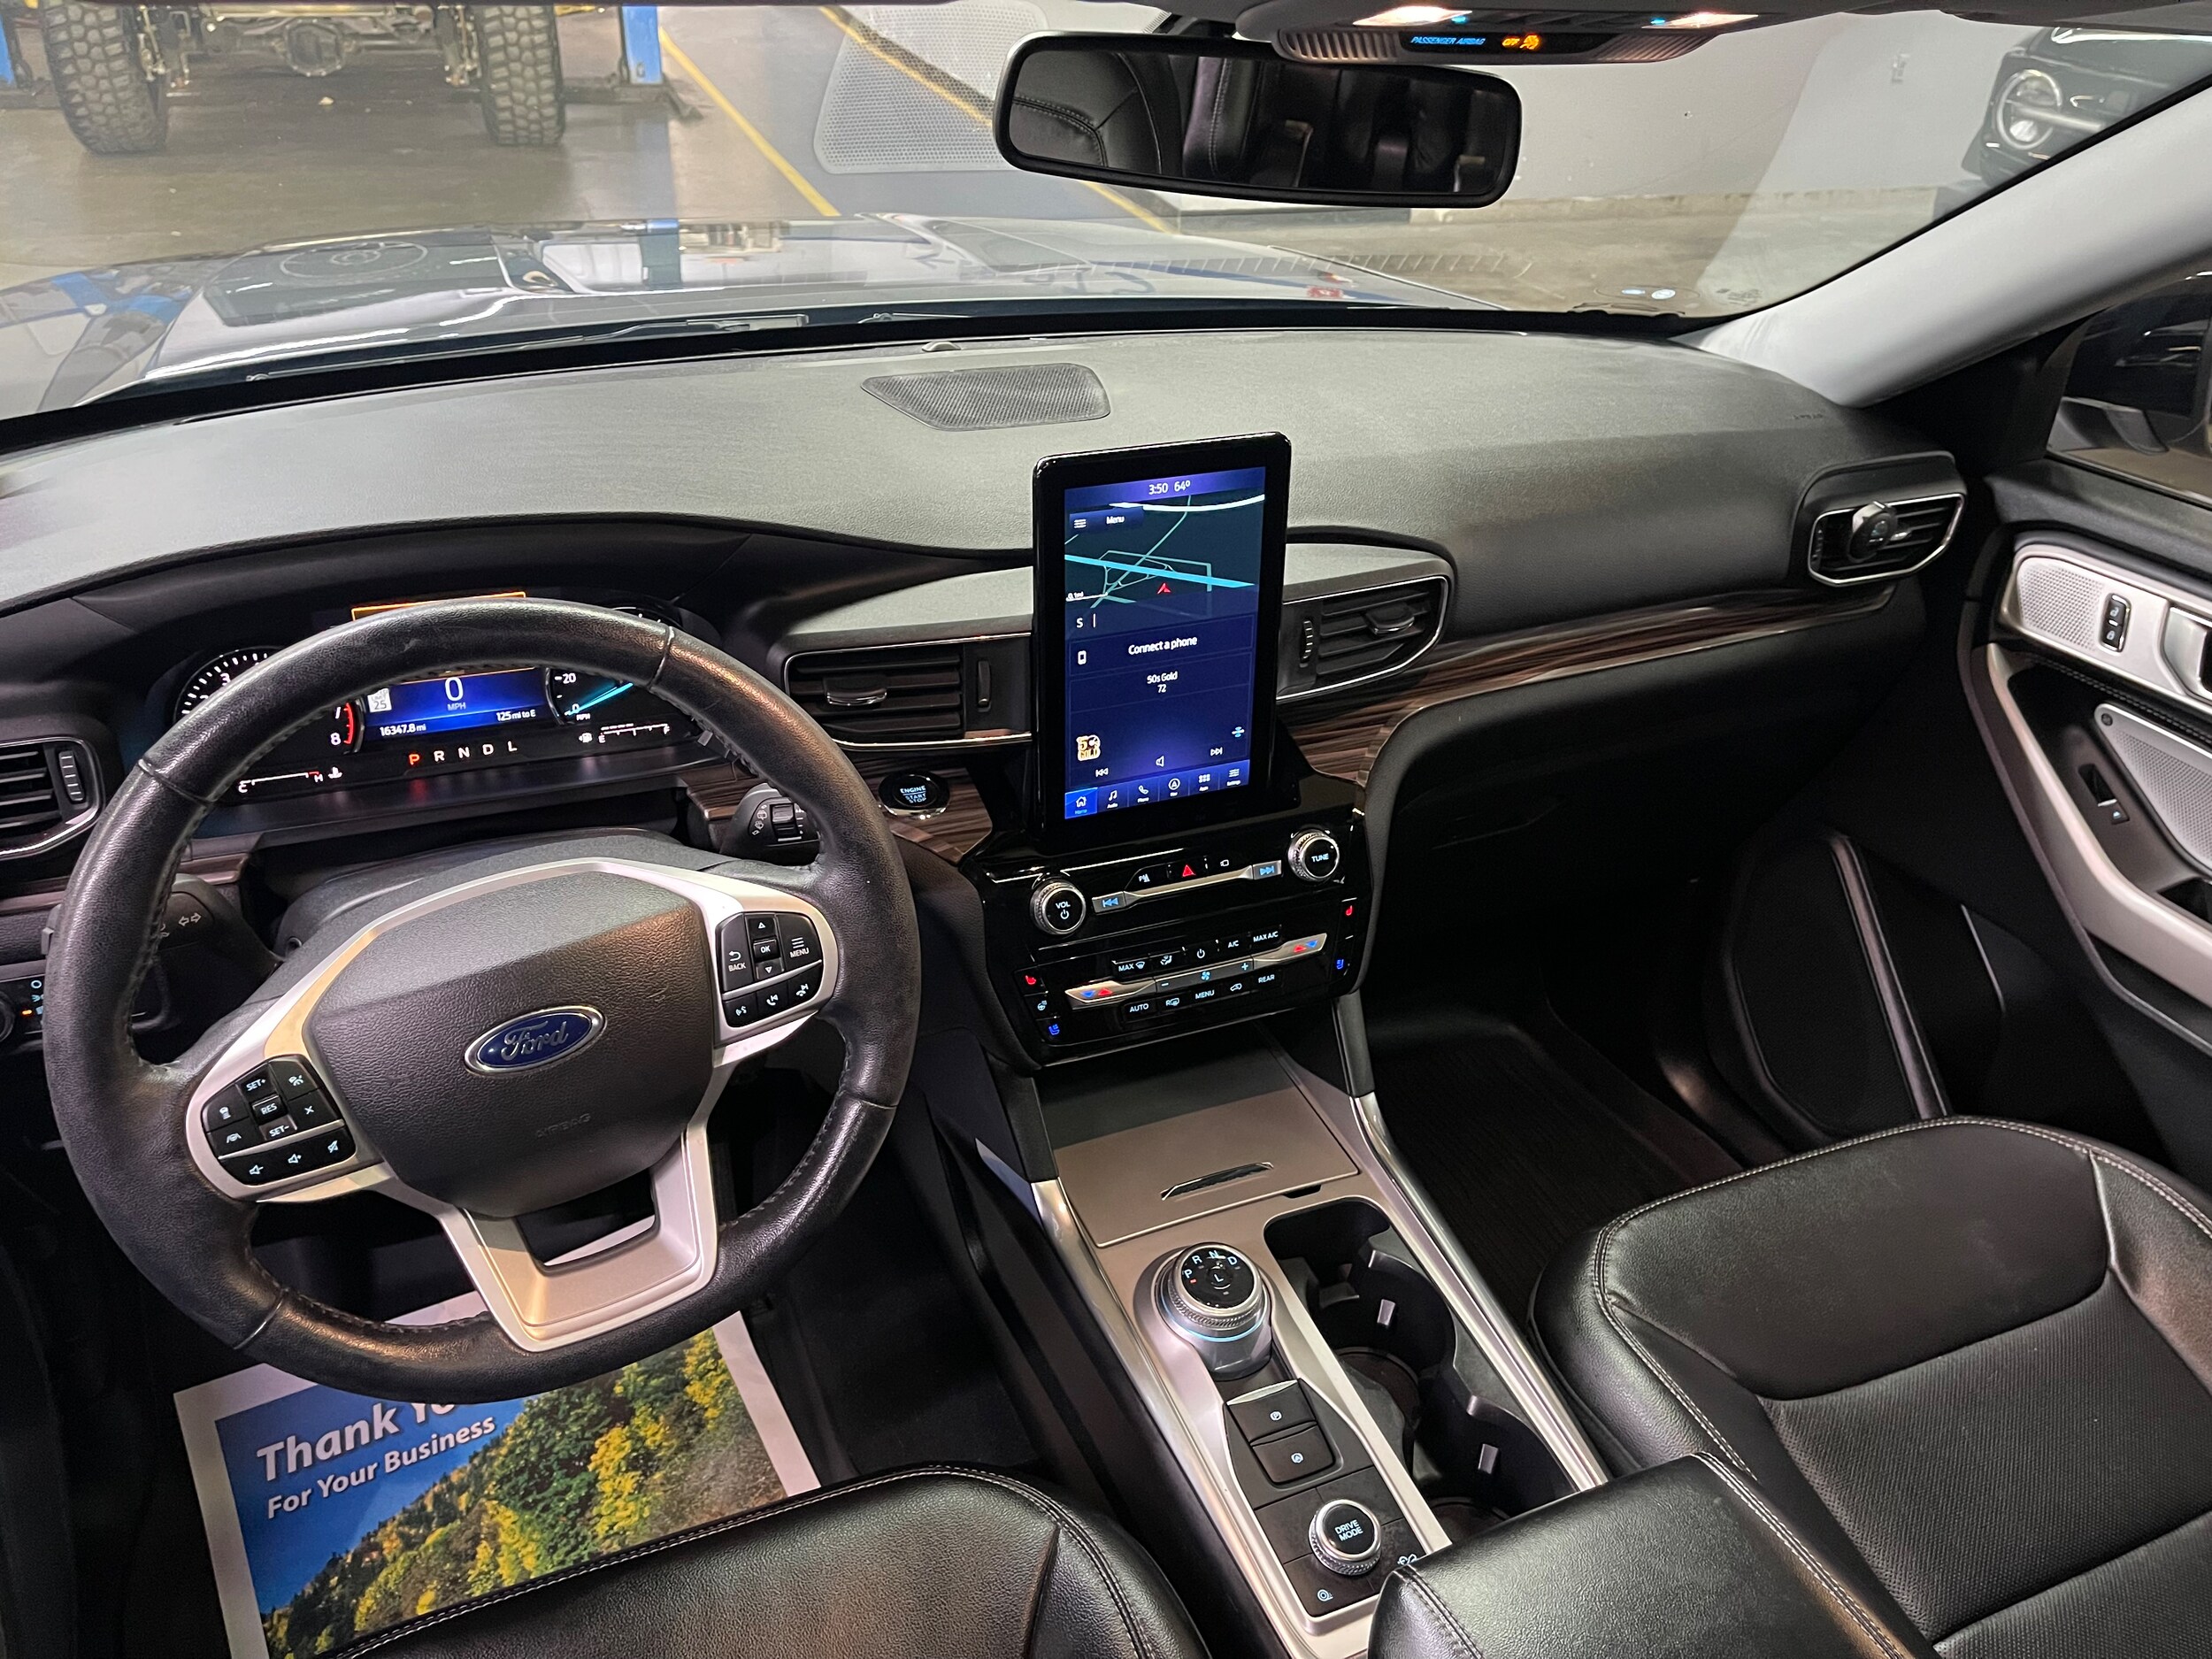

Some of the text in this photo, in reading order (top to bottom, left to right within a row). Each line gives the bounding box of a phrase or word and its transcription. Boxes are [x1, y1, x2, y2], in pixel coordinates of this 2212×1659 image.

[1410, 36, 1486, 46] PASSENGER AIRBAG
[1148, 483, 1168, 495] 3:50
[1106, 515, 1125, 525] Menu
[1076, 618, 1084, 628] S
[1128, 636, 1198, 655] Connect a phone
[563, 672, 576, 685] 20
[1162, 671, 1178, 682] Gold
[444, 677, 464, 702] 0
[1157, 683, 1167, 693] 72
[373, 700, 387, 710] 25
[447, 703, 466, 711] MPH
[496, 710, 511, 722] 125
[522, 710, 530, 718] to
[380, 723, 416, 737] 16347.8
[330, 732, 341, 746] 8
[408, 741, 518, 765] P R N D L
[900, 785, 926, 794] ENGINE
[1311, 853, 1330, 863] TUNE
[1055, 901, 1071, 910] VOL
[1253, 930, 1279, 943] MAX A/C
[760, 945, 771, 954] OK
[1227, 940, 1240, 949] A/C
[789, 948, 810, 958] MENU
[728, 963, 747, 972] BACK
[1118, 963, 1134, 972] MAX
[1258, 974, 1275, 984] REAR
[1194, 989, 1215, 1000] MENU
[1129, 1002, 1149, 1013] AUTO
[501, 1020, 569, 1061] Ford
[260, 1102, 278, 1115] RES
[1184, 1249, 1238, 1279] P R N D
[1213, 1273, 1224, 1282] L
[257, 1402, 400, 1481] Thank
[267, 1416, 495, 1519] For Your Business
[1334, 1519, 1359, 1534] DRIVE
[1338, 1526, 1363, 1541] MODE
